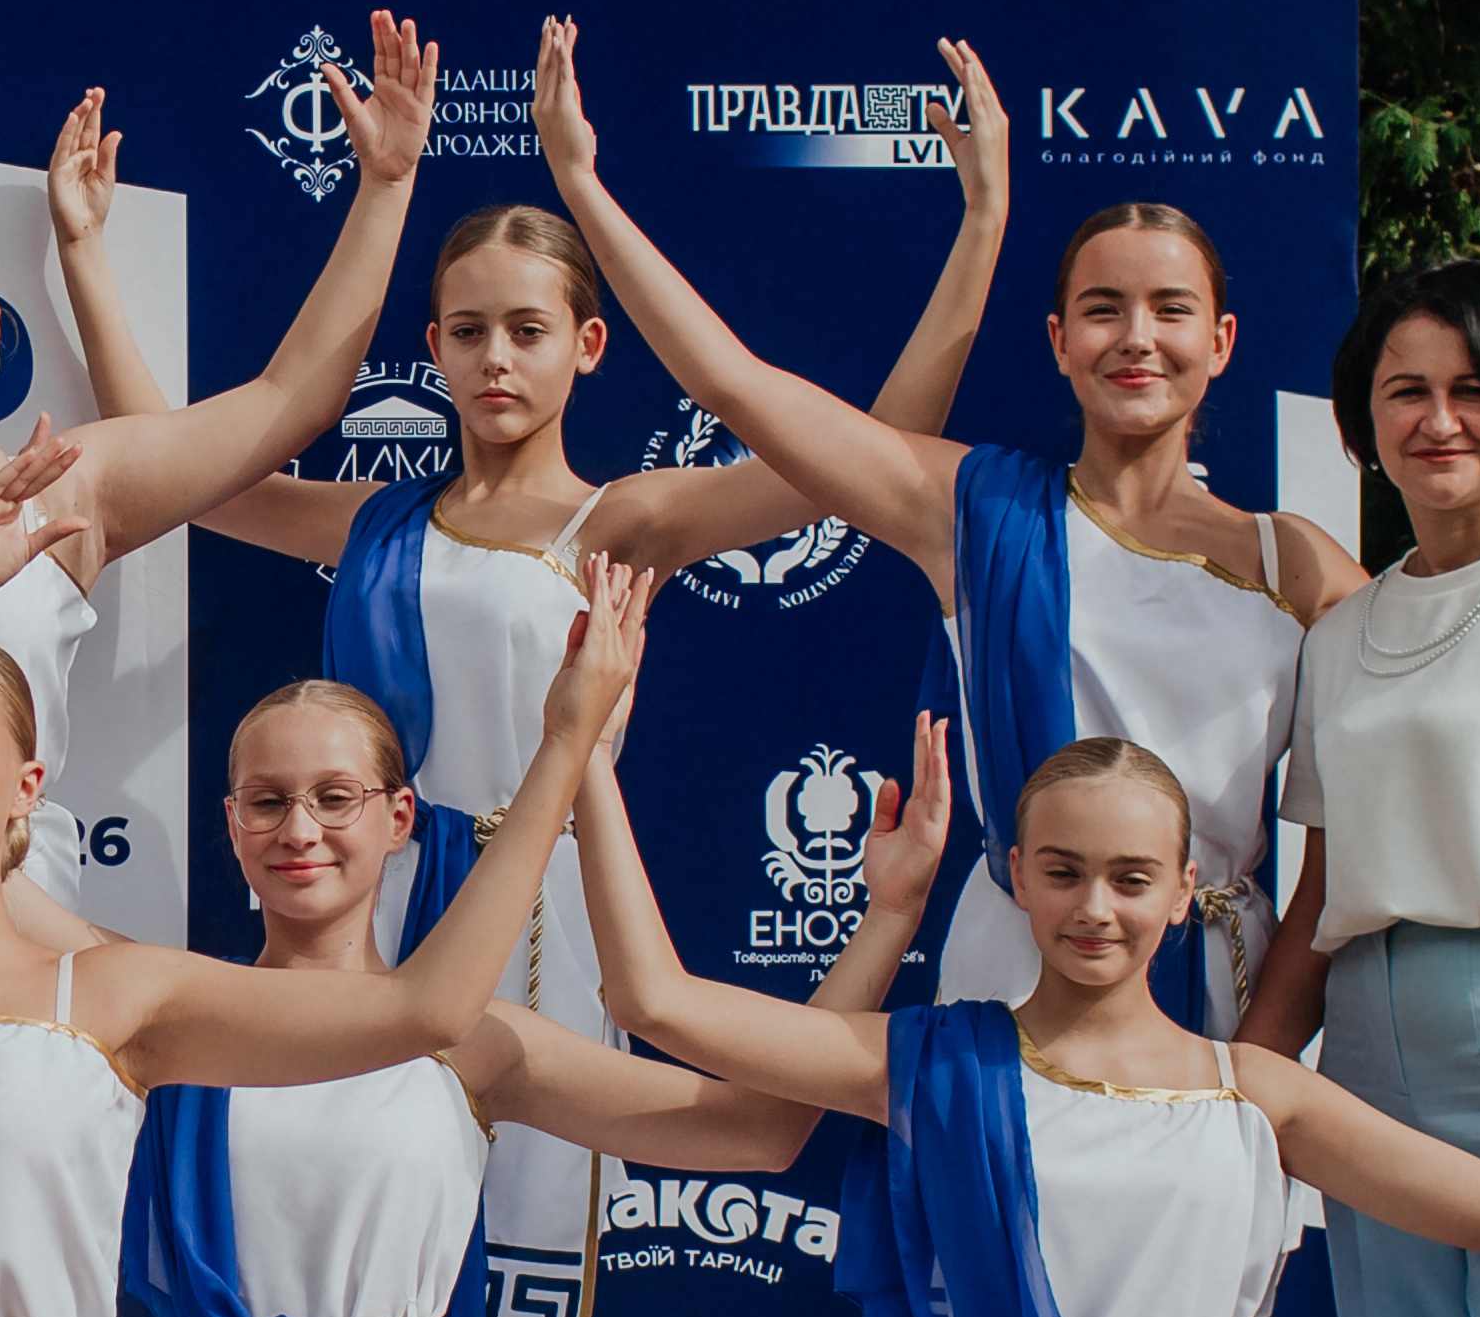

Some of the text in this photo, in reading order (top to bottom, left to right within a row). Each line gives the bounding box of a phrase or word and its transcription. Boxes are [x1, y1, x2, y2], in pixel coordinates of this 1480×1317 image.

[434, 69, 537, 92] НДАЦІЯ
[688, 85, 863, 135] ПРАВДА
[1041, 87, 1324, 139] KAVA
[892, 139, 943, 164] LVI
[1041, 149, 1325, 165] благодійний фонд
[778, 534, 871, 610] FOUNDATION
[750, 910, 864, 947] ЕНОЗ
[732, 950, 815, 967] Товариство
[600, 1244, 783, 1284] ТВОЇЙ ТАРІЛЦІ
